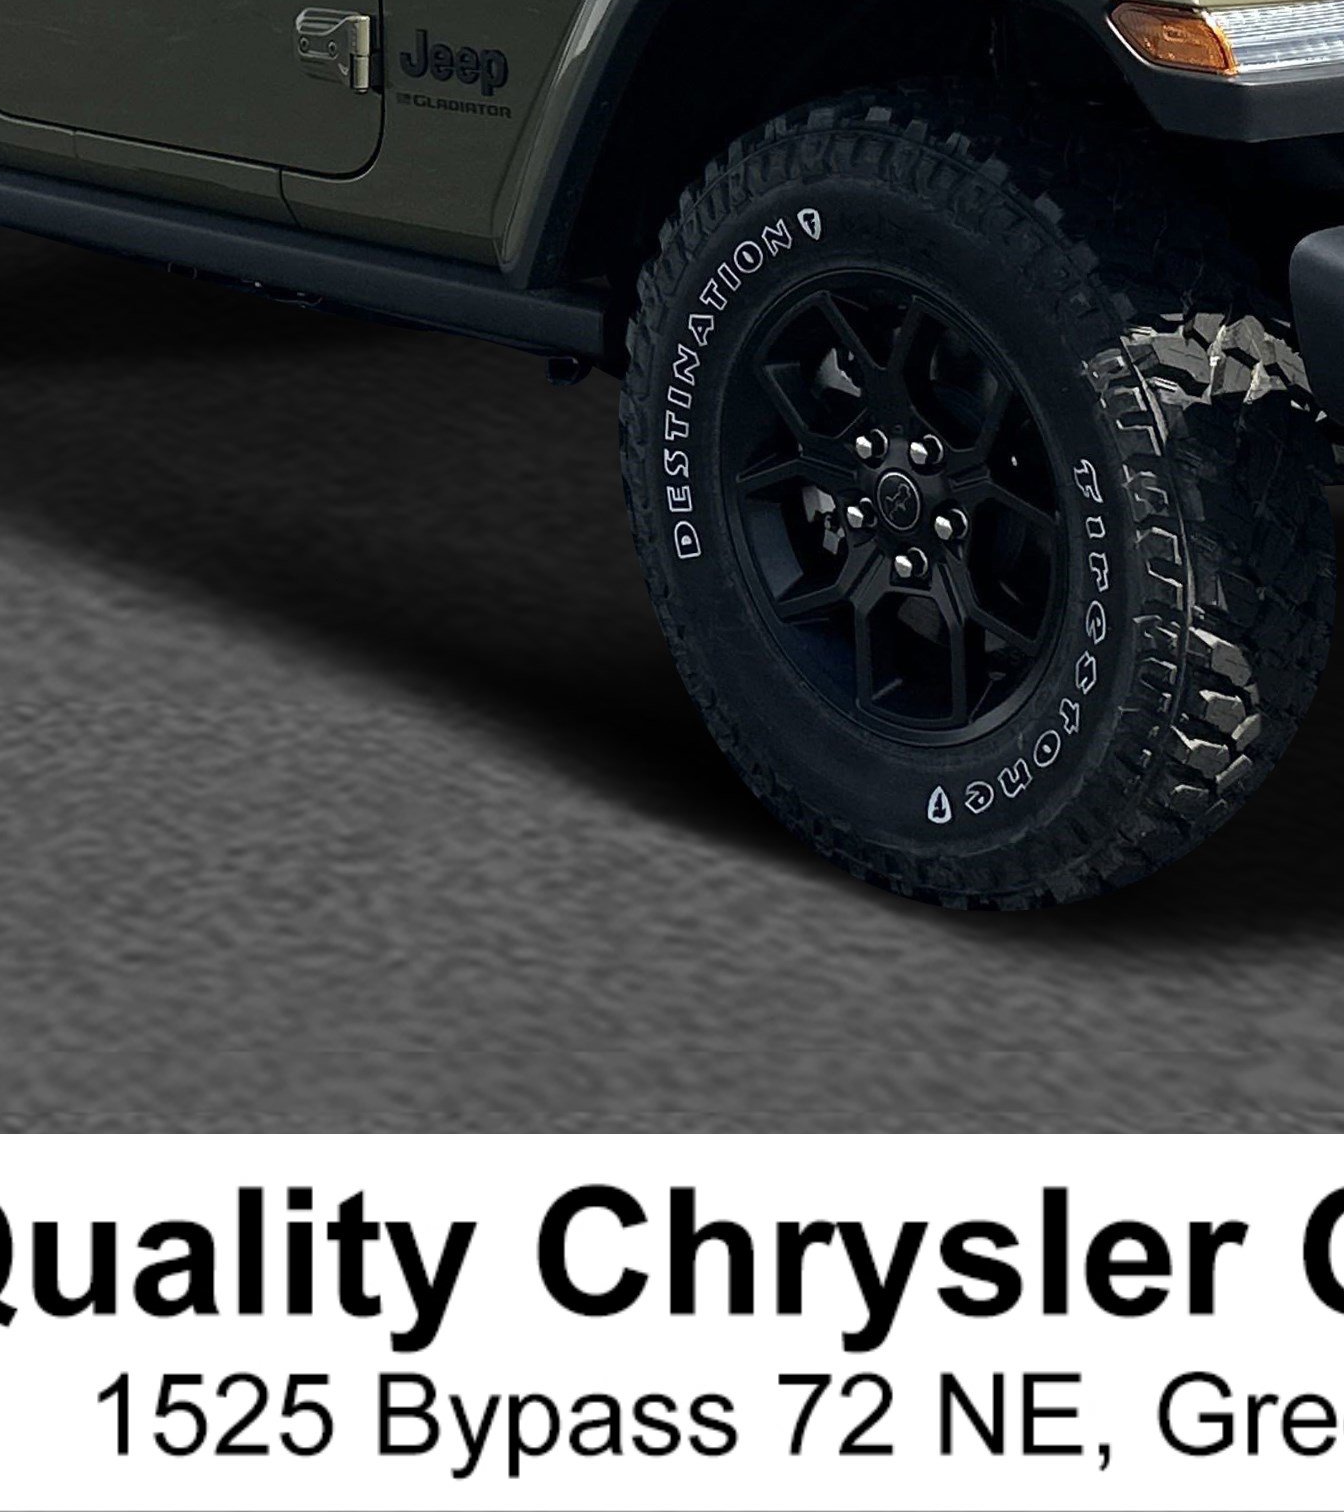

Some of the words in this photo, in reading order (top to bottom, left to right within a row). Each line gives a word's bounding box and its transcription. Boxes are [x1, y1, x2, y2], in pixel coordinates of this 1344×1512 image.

[399, 28, 510, 97] Jeep
[413, 94, 513, 119] GLADIATOR
[663, 217, 794, 561] DESTINATION
[964, 457, 1111, 816] Firestone
